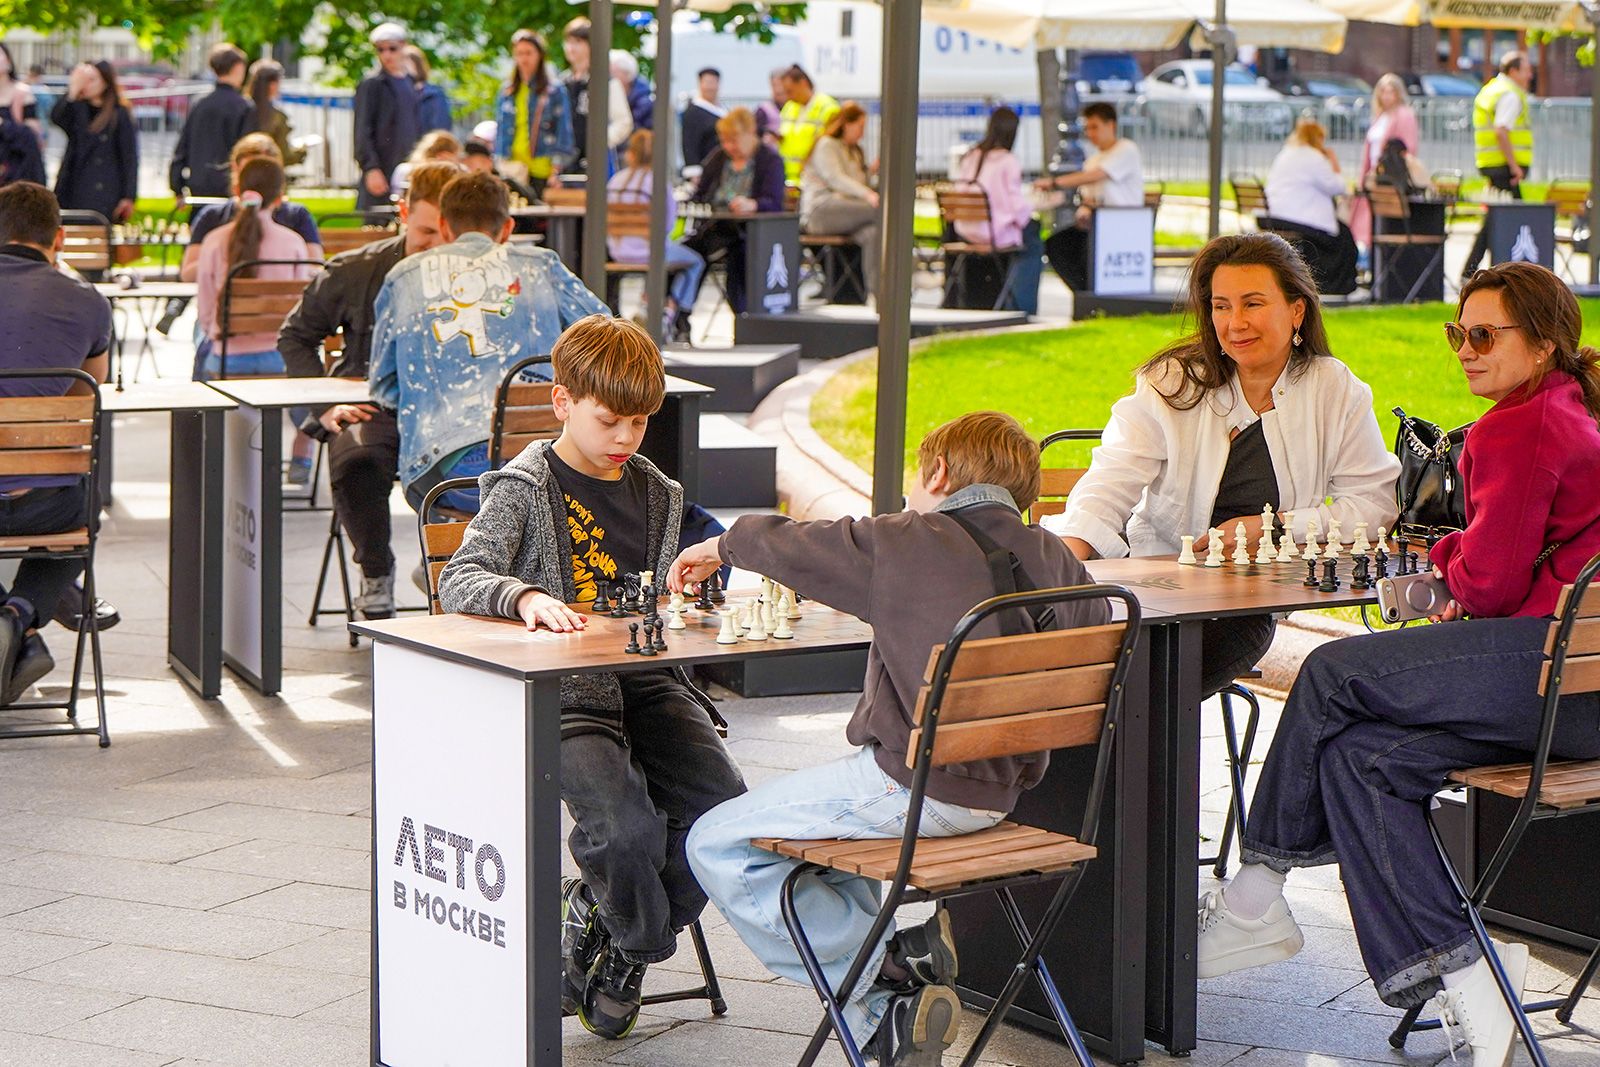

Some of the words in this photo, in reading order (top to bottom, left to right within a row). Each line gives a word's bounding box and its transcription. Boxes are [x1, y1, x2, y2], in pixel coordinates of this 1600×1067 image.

[935, 26, 1022, 54] 01-
[583, 540, 618, 580] YOUR
[393, 815, 506, 902] ЛЕТО
[393, 879, 407, 910] В
[414, 887, 506, 949] МОСКВЕ
